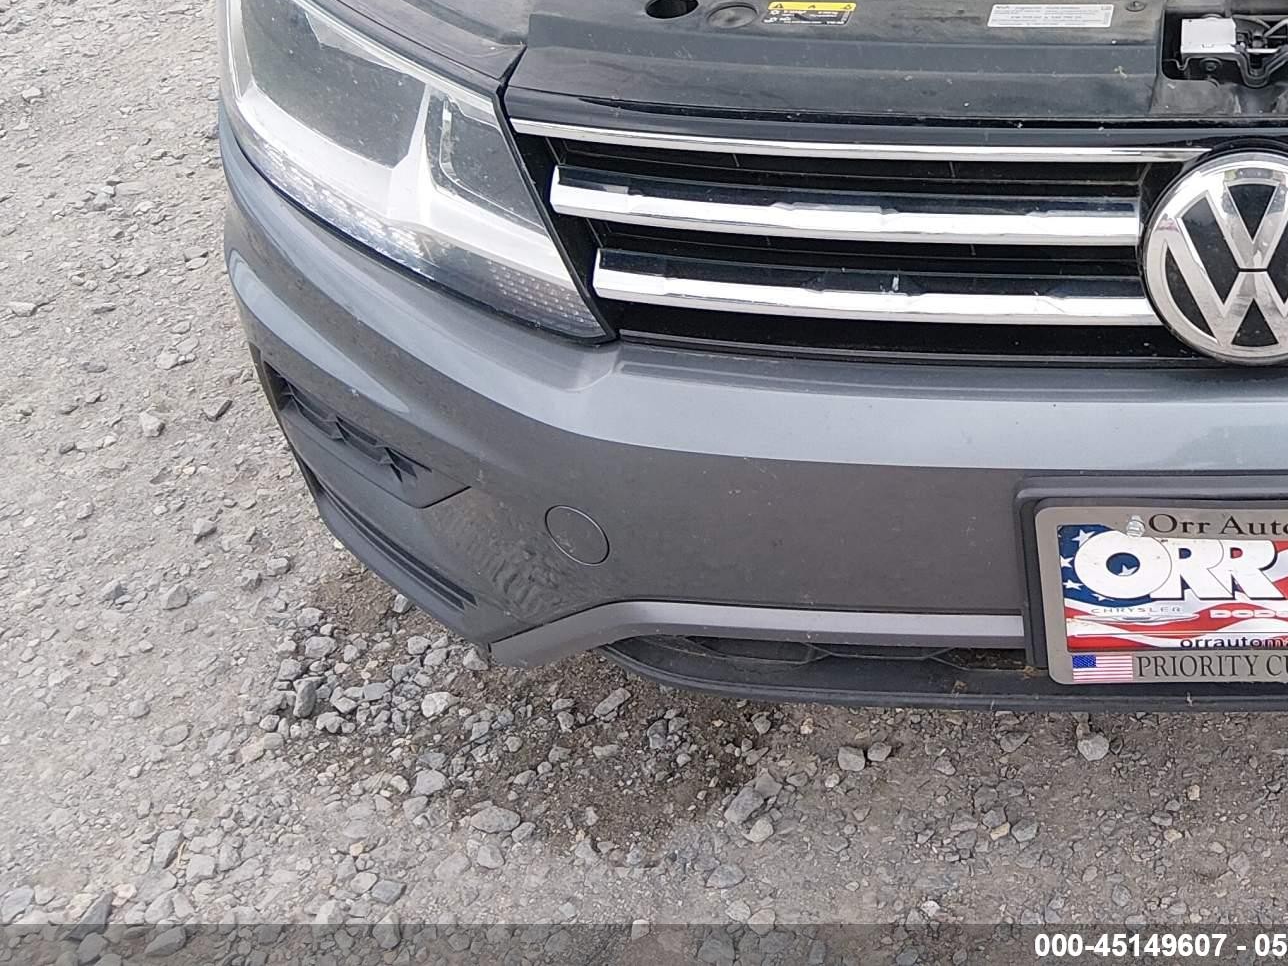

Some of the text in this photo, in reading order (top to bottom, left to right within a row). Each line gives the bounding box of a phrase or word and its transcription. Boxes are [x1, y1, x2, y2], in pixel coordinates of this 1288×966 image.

[1149, 513, 1210, 534] Orr
[1074, 530, 1287, 600] ORR
[1138, 654, 1259, 678] PRIORITY
